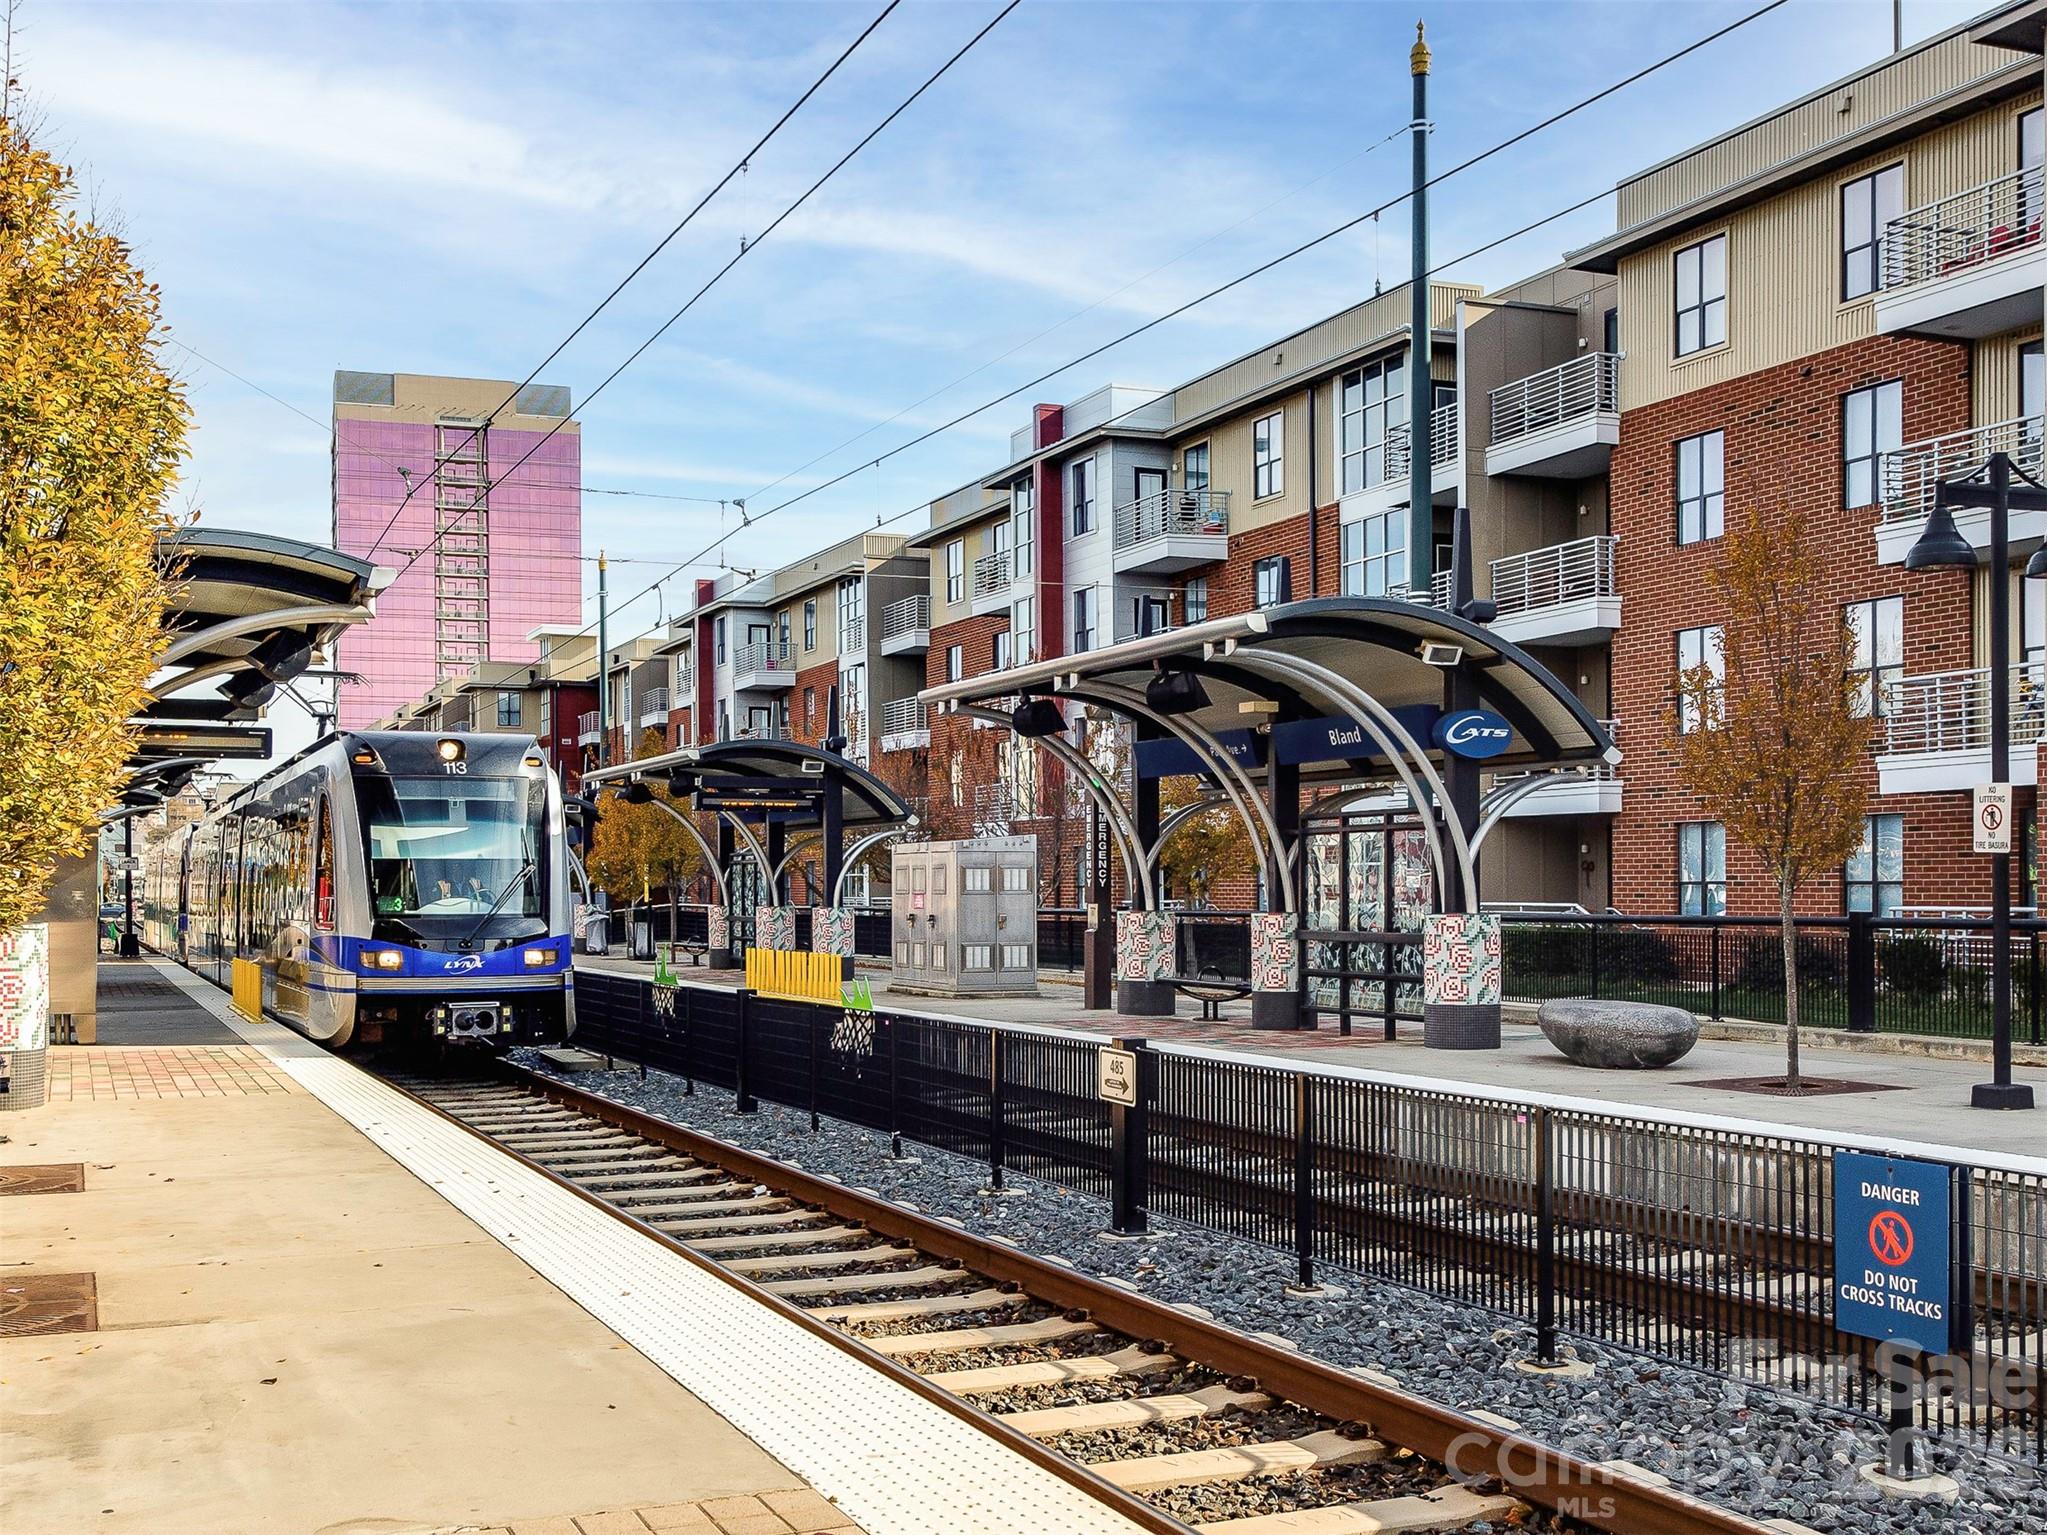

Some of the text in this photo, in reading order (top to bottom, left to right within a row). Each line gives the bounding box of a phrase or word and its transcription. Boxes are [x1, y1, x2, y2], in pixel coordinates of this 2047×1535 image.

[1328, 726, 1362, 746] Bland
[1446, 716, 1510, 744] CATS
[443, 762, 467, 775] 113
[1979, 795, 2006, 803] LITTERING
[444, 958, 486, 971] LYNX
[1110, 1060, 1124, 1075] 485
[1861, 1182, 1920, 1206] DANGER
[1864, 1269, 1918, 1294] DO NOT
[1840, 1284, 1942, 1320] CROSS TRACKS
